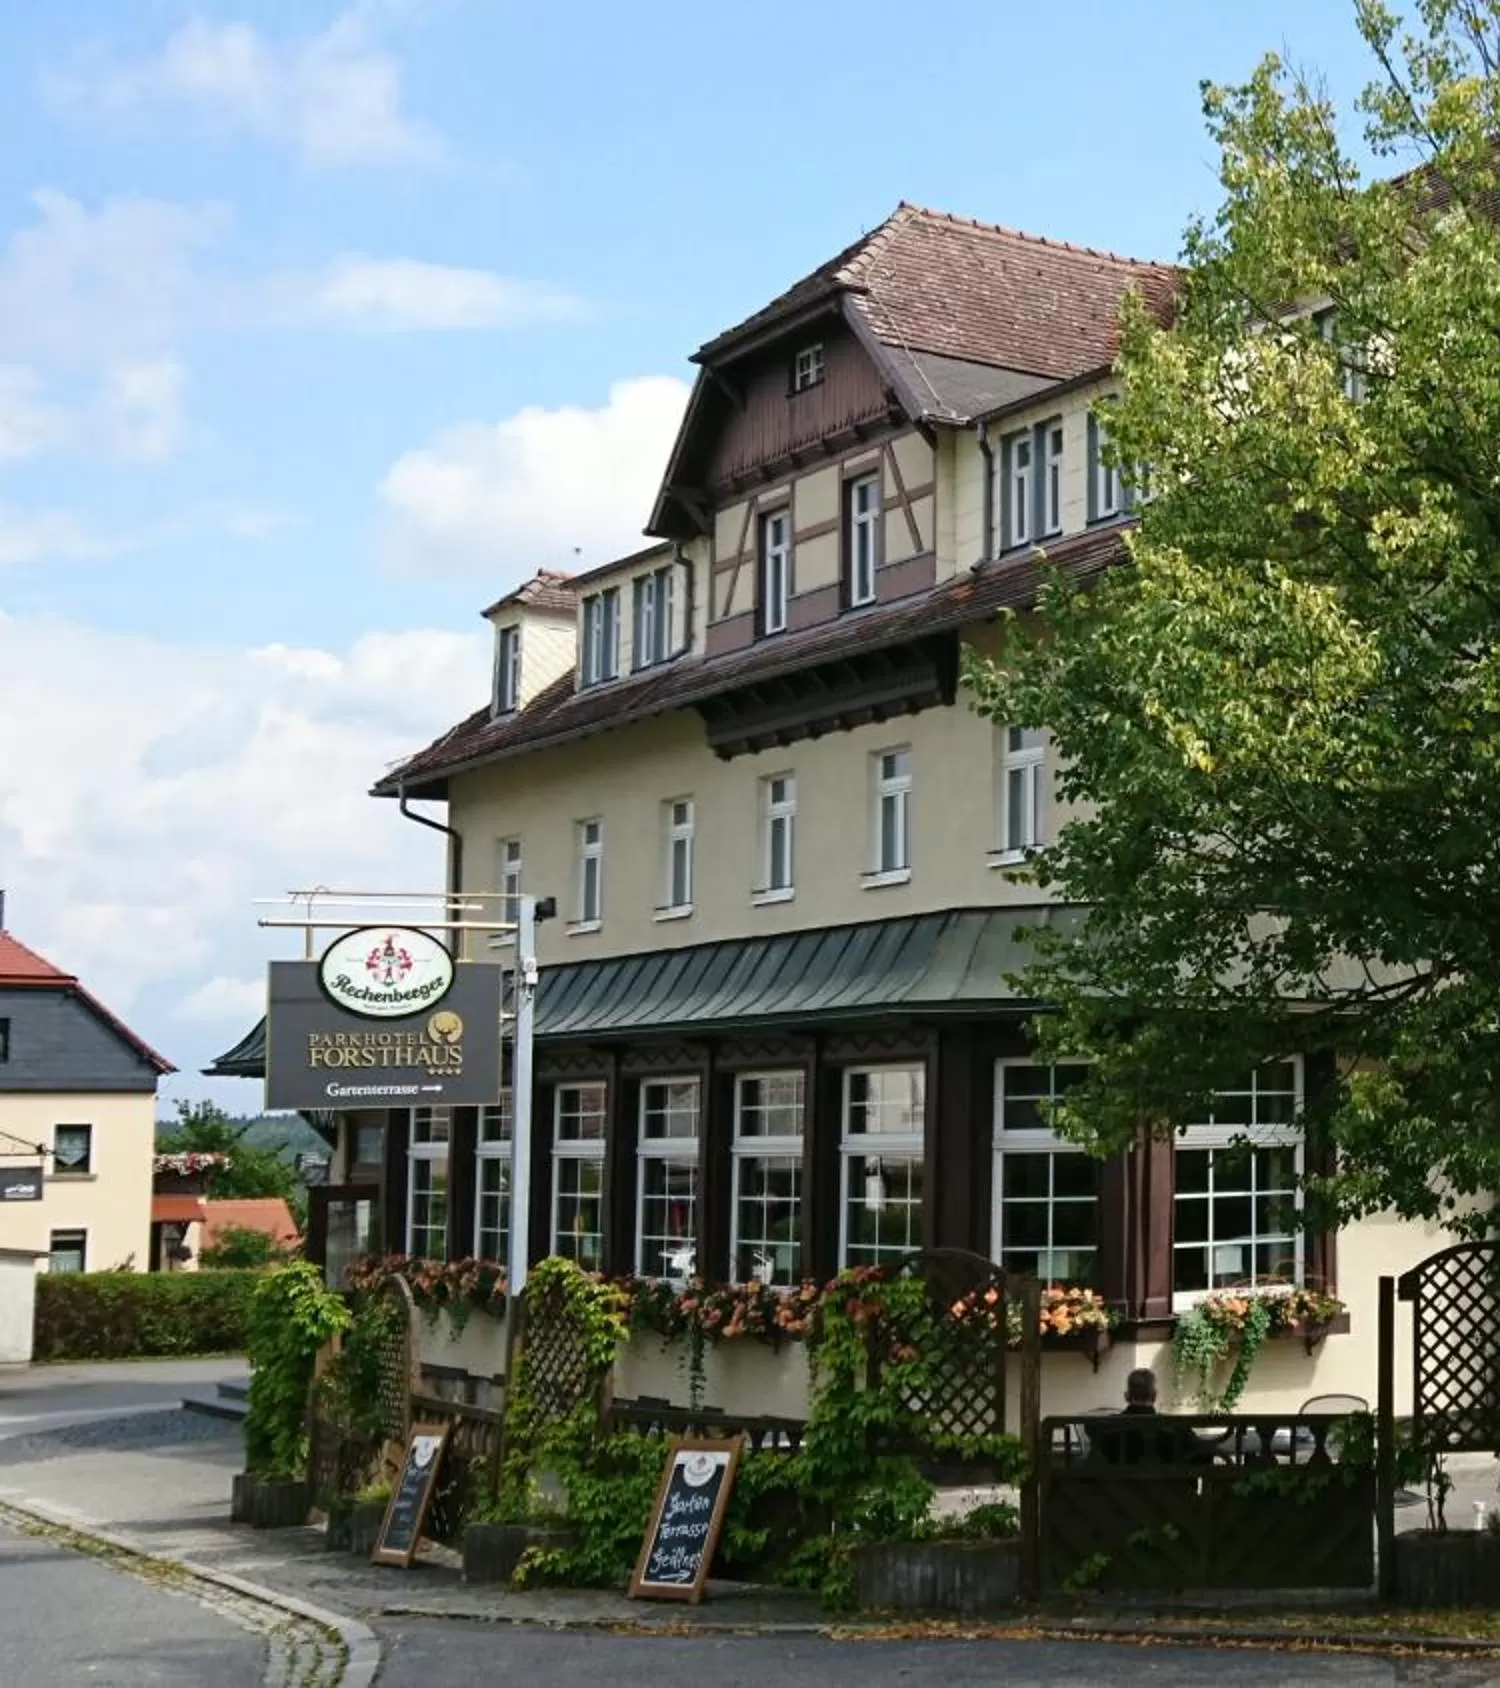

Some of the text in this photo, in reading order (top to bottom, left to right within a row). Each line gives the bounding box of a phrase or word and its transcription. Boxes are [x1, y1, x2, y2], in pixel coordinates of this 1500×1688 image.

[331, 973, 445, 1003] Rechenberger
[308, 1033, 429, 1046] PARKHOTEL
[309, 1046, 463, 1068] FORSTHAUS
[326, 1082, 419, 1097] Gartenterrasse
